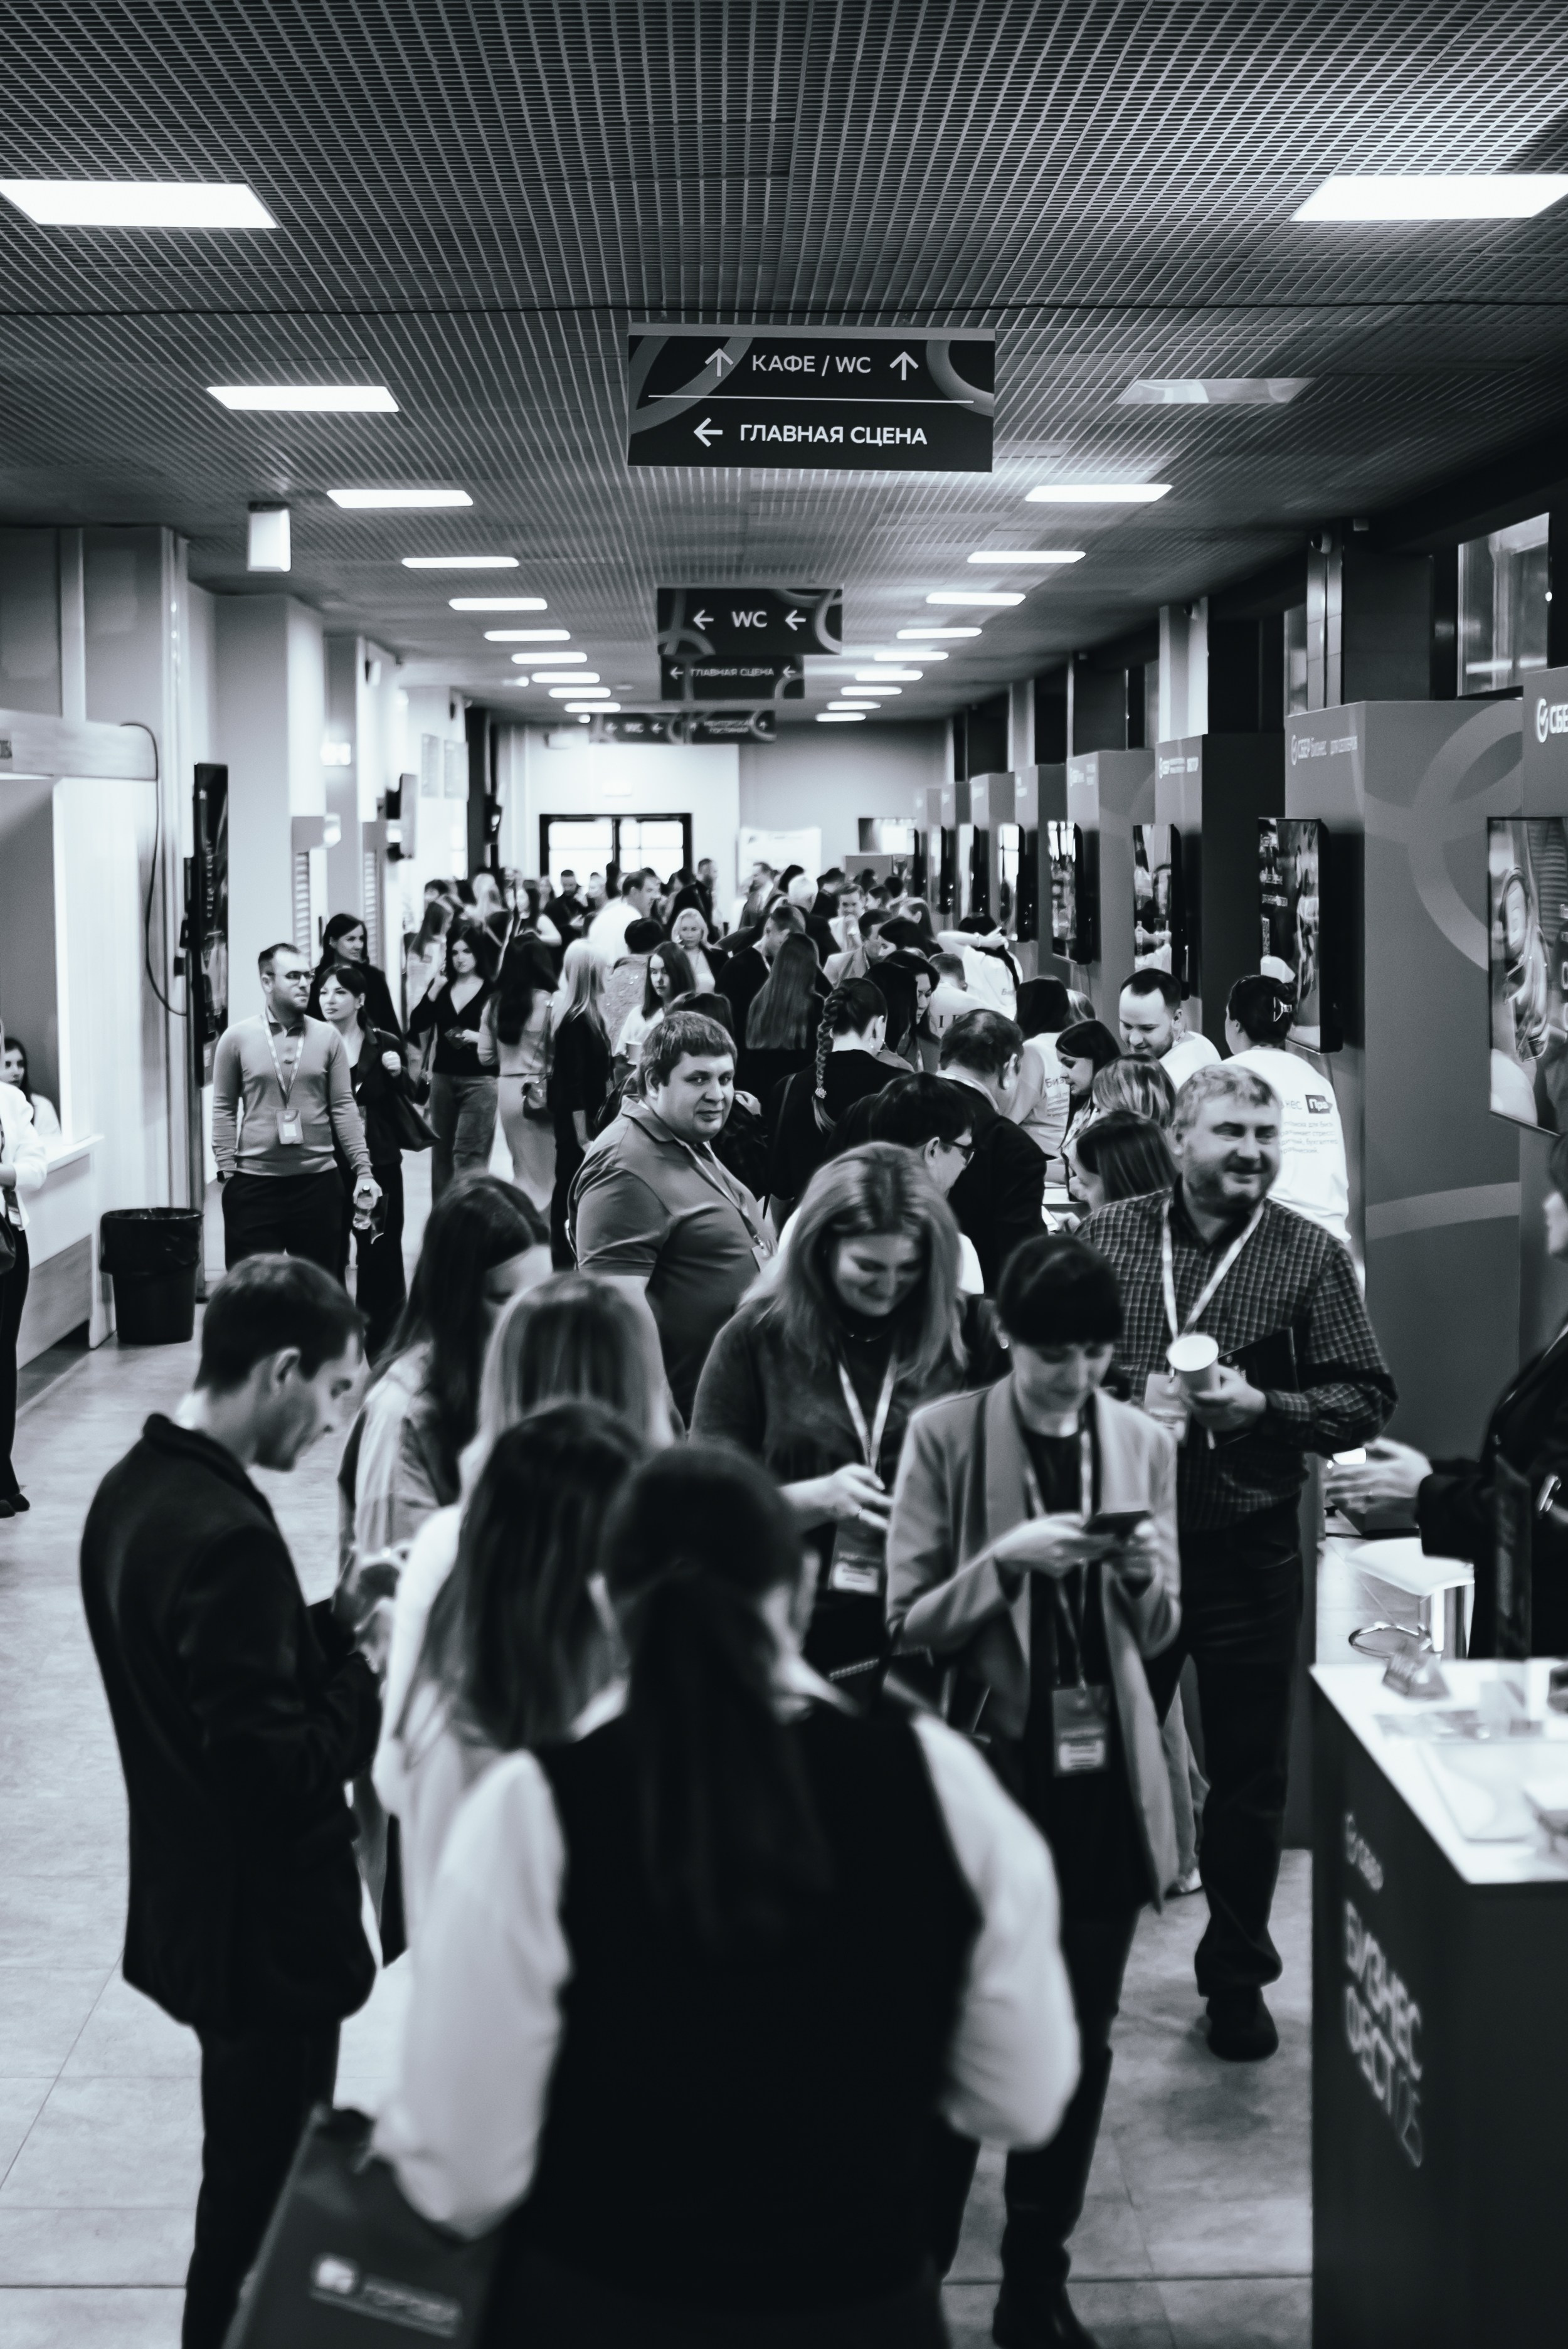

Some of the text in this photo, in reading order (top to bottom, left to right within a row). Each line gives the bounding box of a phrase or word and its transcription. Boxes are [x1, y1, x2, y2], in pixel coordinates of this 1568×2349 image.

[753, 355, 871, 377] КАФЕ / WC
[740, 424, 928, 447] ГЛАВНАЯ СЦЕНА
[732, 611, 768, 628] WC
